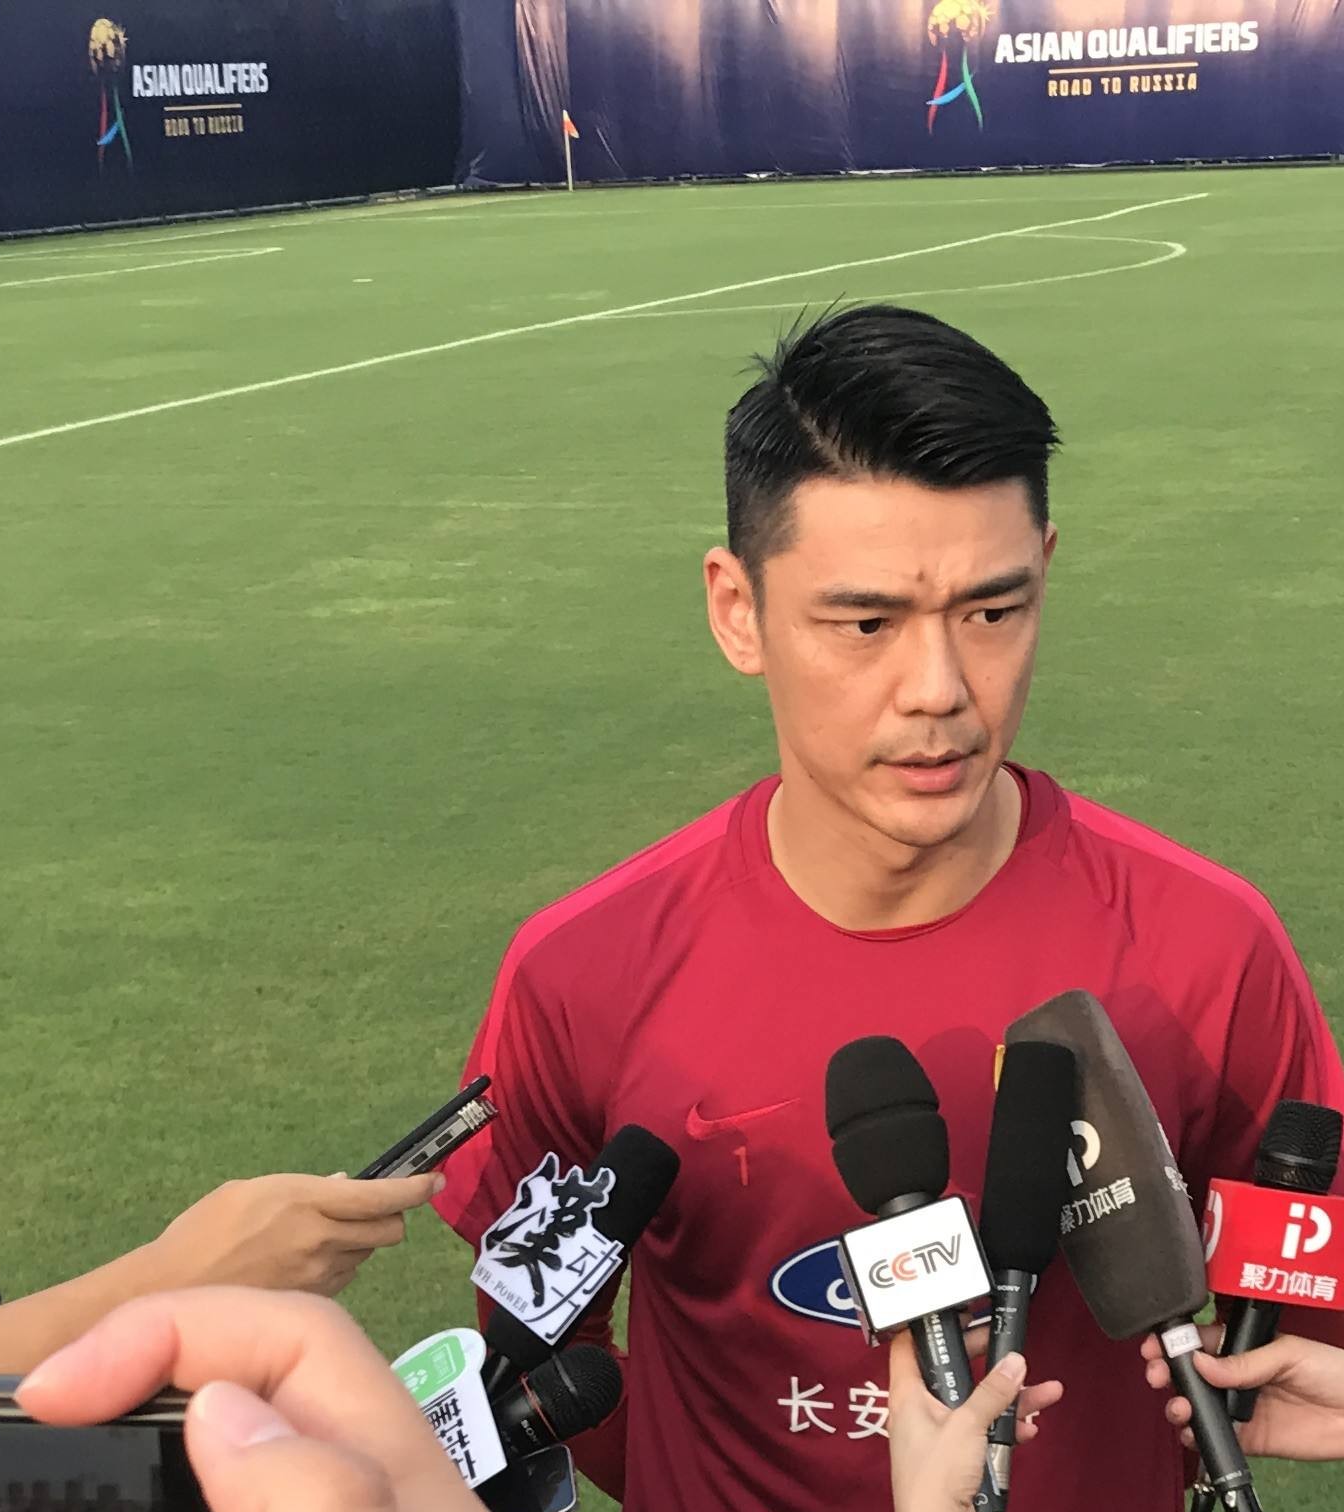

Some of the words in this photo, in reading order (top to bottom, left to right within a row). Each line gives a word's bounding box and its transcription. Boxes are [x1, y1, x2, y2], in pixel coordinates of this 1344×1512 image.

[994, 30, 1085, 63] ASIAN
[1087, 21, 1259, 59] QUALIFIERS
[132, 64, 181, 97] ASIAN
[182, 62, 269, 96] QUALIFIERS
[1048, 78, 1092, 97] ROAD
[1101, 76, 1122, 95] TO
[1129, 73, 1198, 93] RUSSIA
[734, 1146, 750, 1187] 1
[1060, 1176, 1136, 1234] 聚力体育
[868, 1232, 961, 1289] CCTV
[1239, 1262, 1339, 1302] 聚力体育
[776, 1376, 891, 1440] 长安
